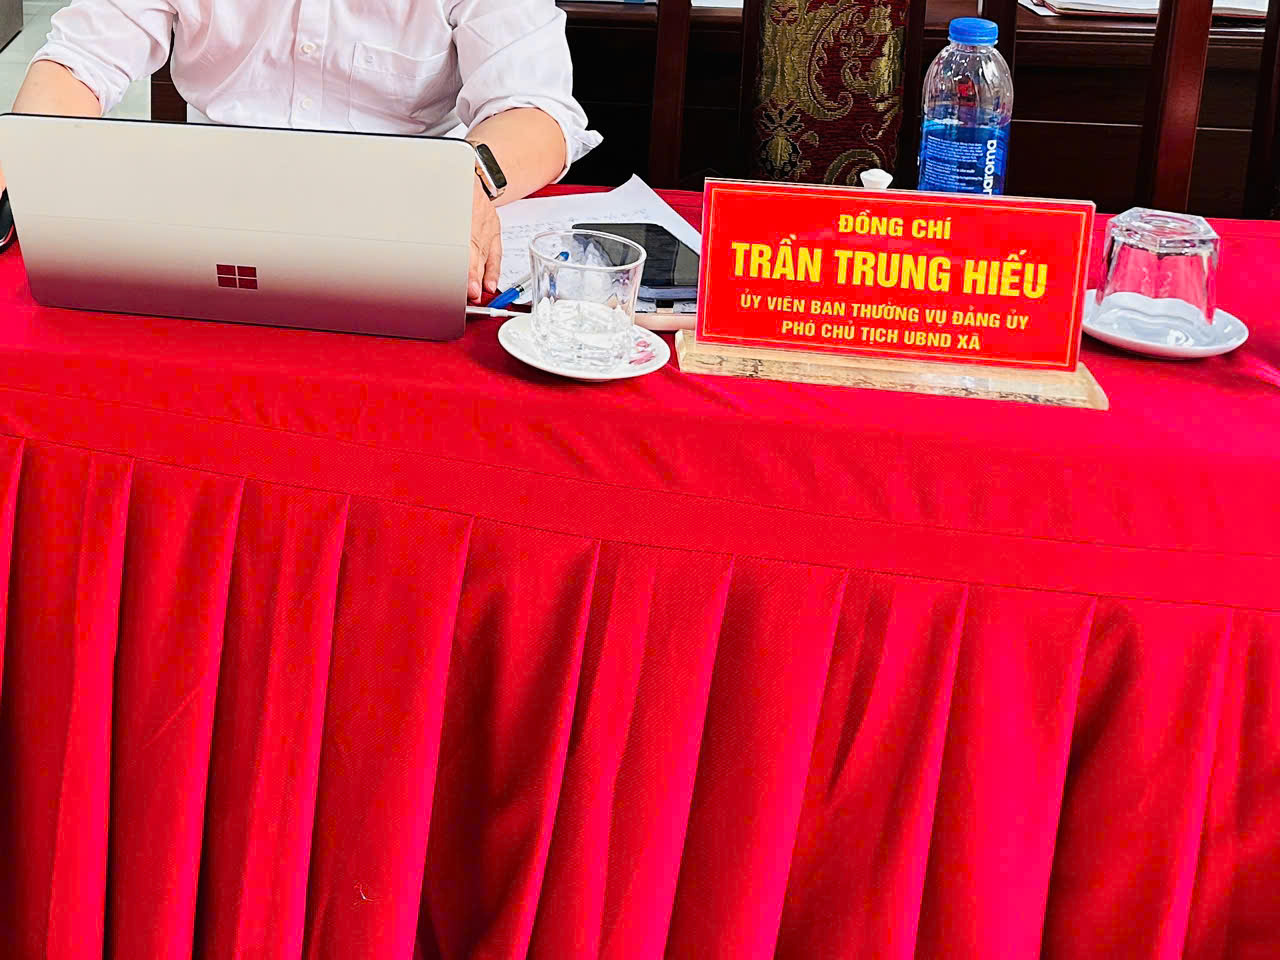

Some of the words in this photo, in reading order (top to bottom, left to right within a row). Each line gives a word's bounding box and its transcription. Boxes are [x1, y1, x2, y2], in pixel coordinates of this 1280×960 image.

[838, 209, 904, 237] ĐỒNG
[911, 217, 952, 240] CHÍ
[731, 233, 823, 283] TRẦN
[833, 249, 951, 293] TRUNG
[963, 249, 1048, 299] HIẾU
[740, 288, 762, 309] ỦY
[767, 296, 806, 313] VIÊN
[811, 300, 846, 316] BAN
[851, 300, 920, 323] THƯỜNG
[925, 309, 947, 327] VỤ
[951, 305, 1001, 328] ĐẢNG
[1006, 309, 1029, 330] ỦY
[781, 319, 816, 337] PHÓ
[821, 320, 855, 340] CHỦ
[860, 326, 899, 345] TỊCH
[904, 330, 952, 348] UBND
[957, 333, 981, 351] XÃ
